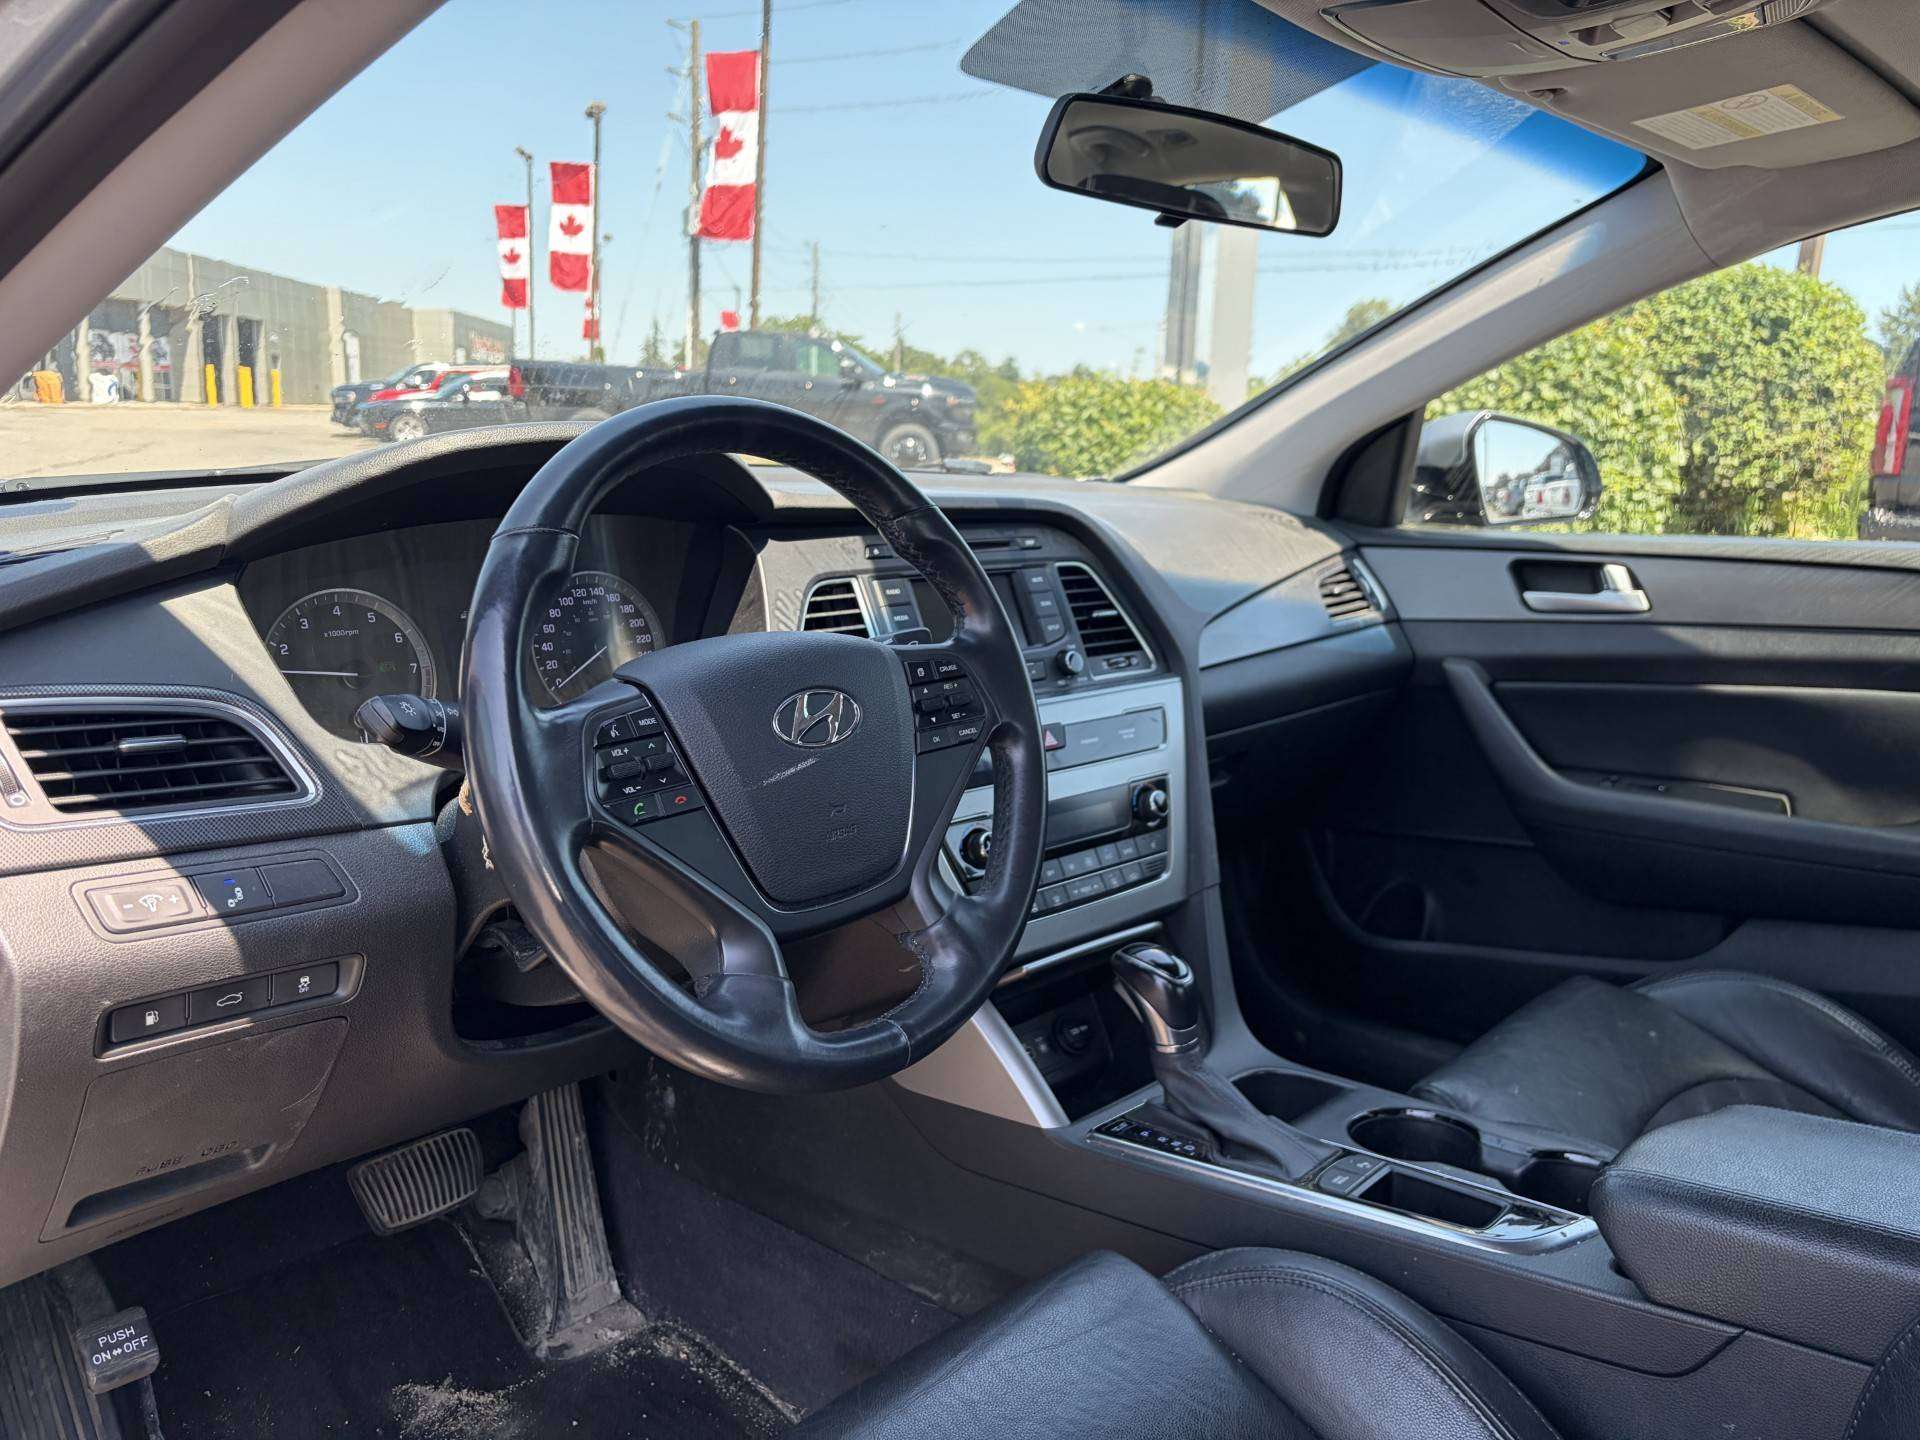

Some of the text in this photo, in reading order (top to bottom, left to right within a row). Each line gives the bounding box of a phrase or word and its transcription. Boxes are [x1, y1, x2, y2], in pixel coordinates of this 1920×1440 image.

[572, 588, 587, 598] 120
[589, 587, 605, 596] 140
[558, 597, 574, 606] 100
[604, 593, 620, 602] 160
[332, 606, 342, 616] 4
[549, 608, 561, 618] 80
[620, 604, 634, 614] 180
[367, 612, 376, 623] 5
[300, 618, 309, 630] 3
[628, 618, 645, 628] 200
[542, 624, 555, 634] 60
[394, 632, 403, 644] 6
[636, 634, 652, 643] 220
[280, 644, 289, 655] 2
[542, 642, 554, 652] 40
[410, 663, 418, 674] 7
[546, 660, 558, 670] 20
[940, 664, 958, 672] CRUISE
[638, 718, 658, 726] MODE
[958, 728, 978, 736] CANCEL
[98, 1326, 136, 1348] PUSH
[92, 1335, 149, 1365] ON OFF
